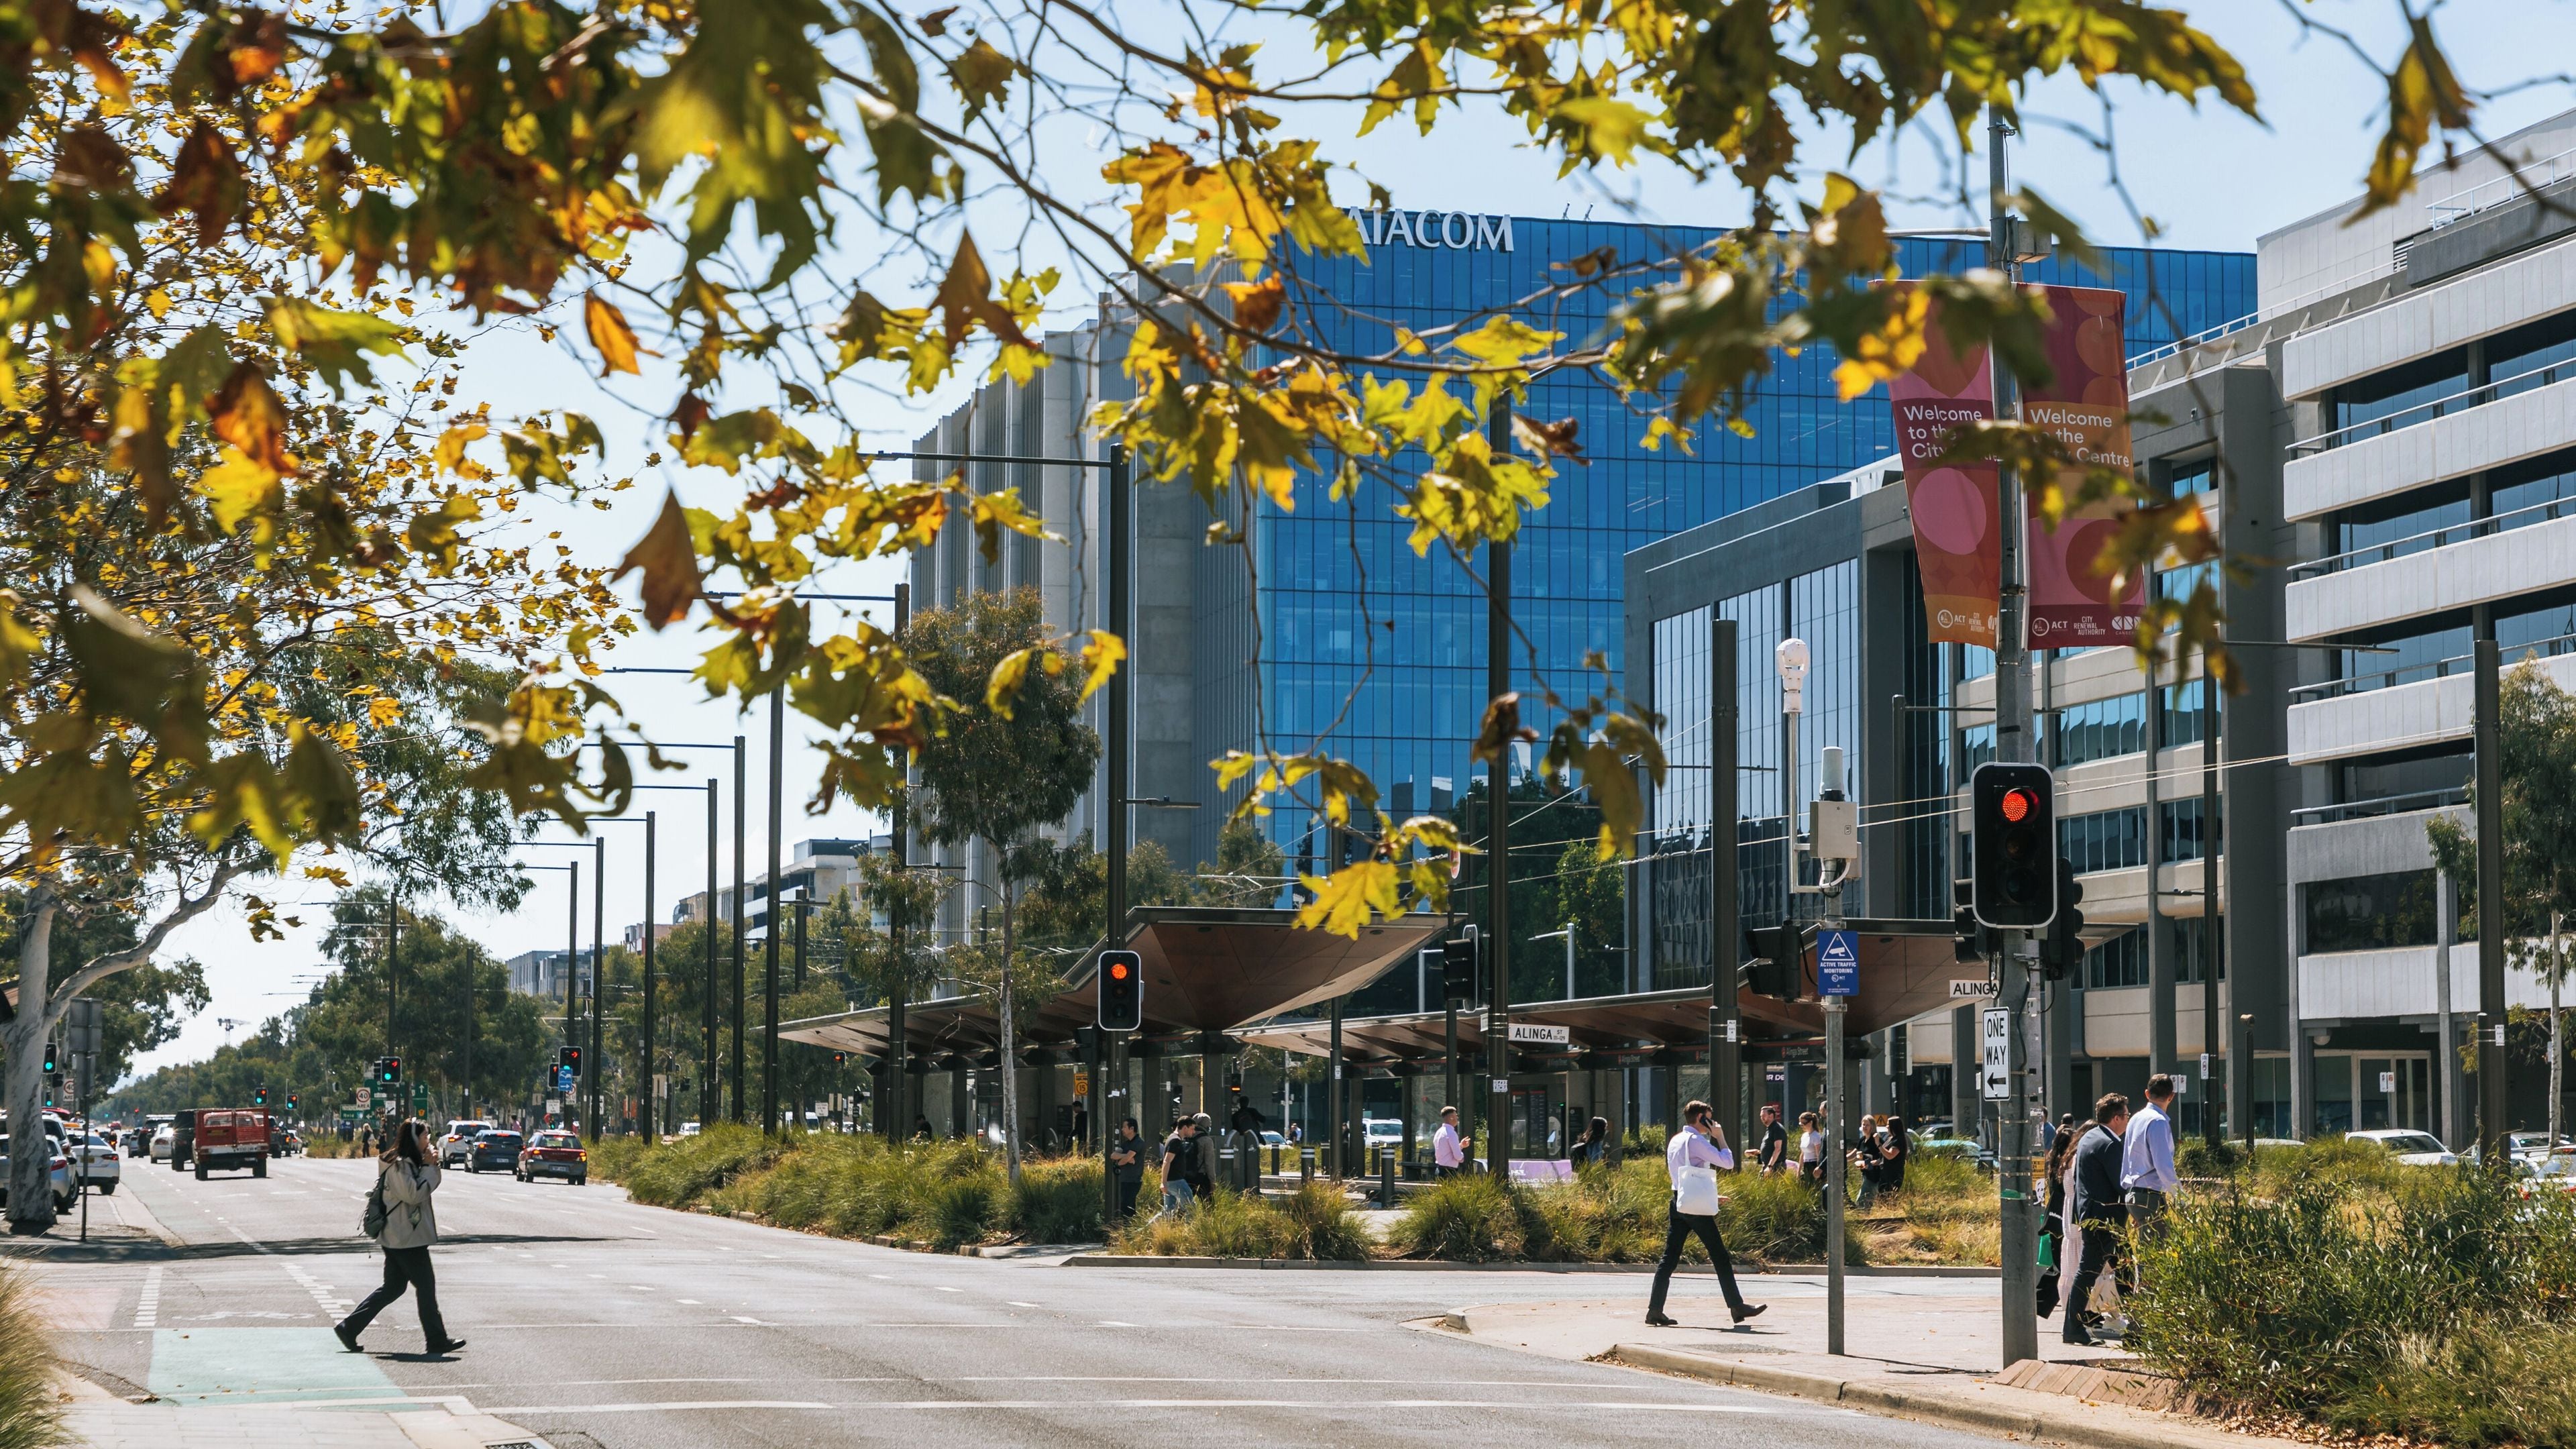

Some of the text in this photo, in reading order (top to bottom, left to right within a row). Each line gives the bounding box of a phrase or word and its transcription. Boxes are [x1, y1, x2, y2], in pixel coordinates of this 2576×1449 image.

[1903, 405, 1982, 421] Welcome
[2030, 408, 2112, 428] Welcome
[1907, 426, 1927, 439] to
[2055, 427, 2084, 443] the
[2076, 447, 2130, 468] Centre
[1954, 614, 1966, 623] ACT
[2051, 621, 2068, 629] ACT
[1953, 983, 1998, 996] ALINGA
[1515, 1027, 1552, 1040] ALINGA
[1987, 1017, 2005, 1037] ONE
[1986, 1045, 2006, 1066] WAY
[1079, 1084, 1086, 1092] 15
